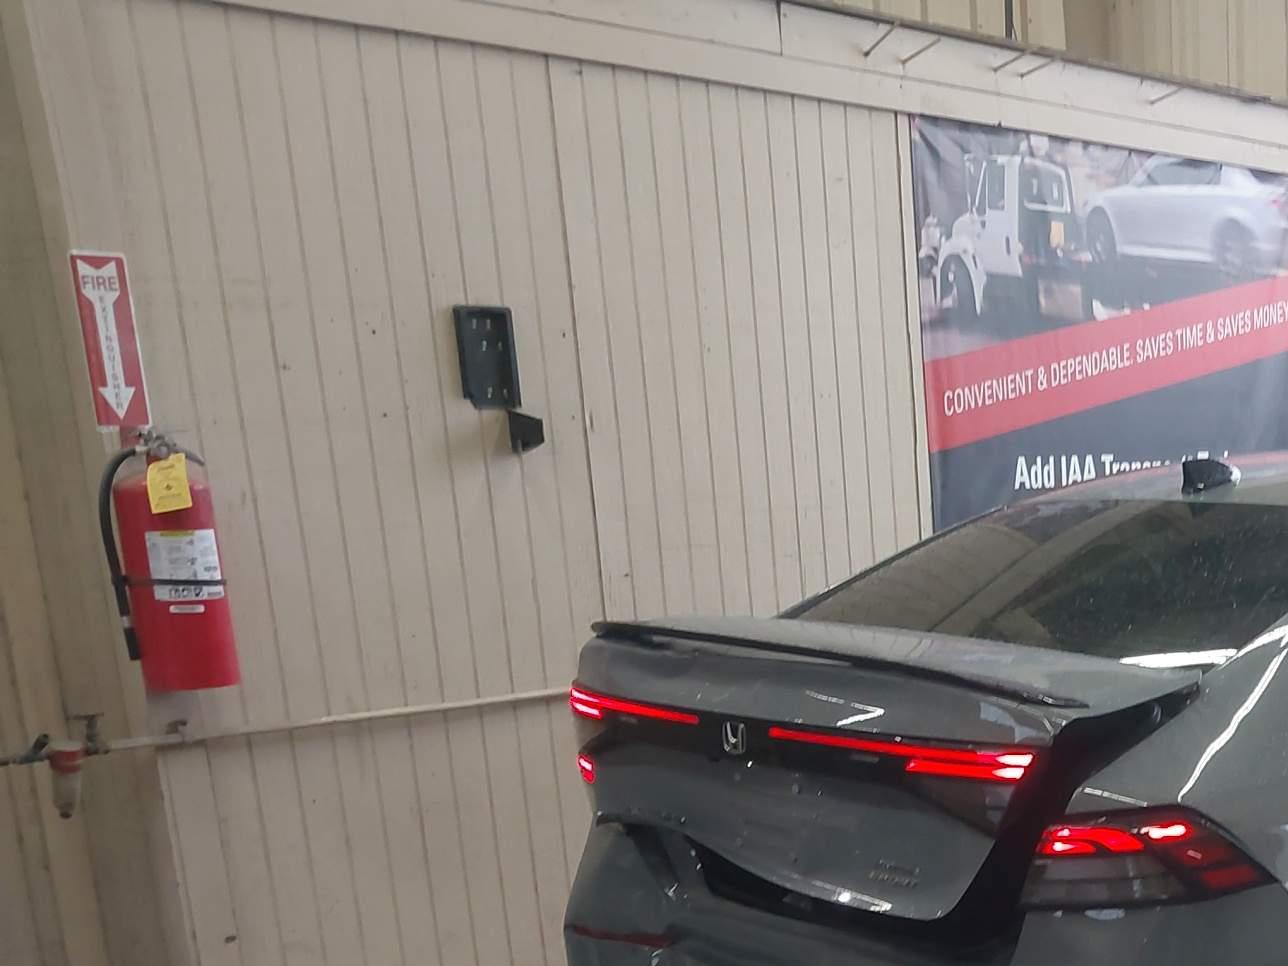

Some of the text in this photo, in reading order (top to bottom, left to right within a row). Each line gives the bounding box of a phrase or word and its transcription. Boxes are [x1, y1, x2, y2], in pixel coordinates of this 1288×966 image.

[81, 275, 118, 292] FIRE
[943, 369, 1035, 417] CONVENIENT
[1037, 363, 1049, 391] &
[1050, 345, 1135, 389] DEPENDABLE.
[1136, 335, 1174, 364] SAVES
[1175, 323, 1204, 353] TIME
[1206, 319, 1216, 344] &
[1217, 310, 1252, 341] SAVES
[1014, 455, 1055, 490] Add
[1061, 453, 1096, 488] IAA
